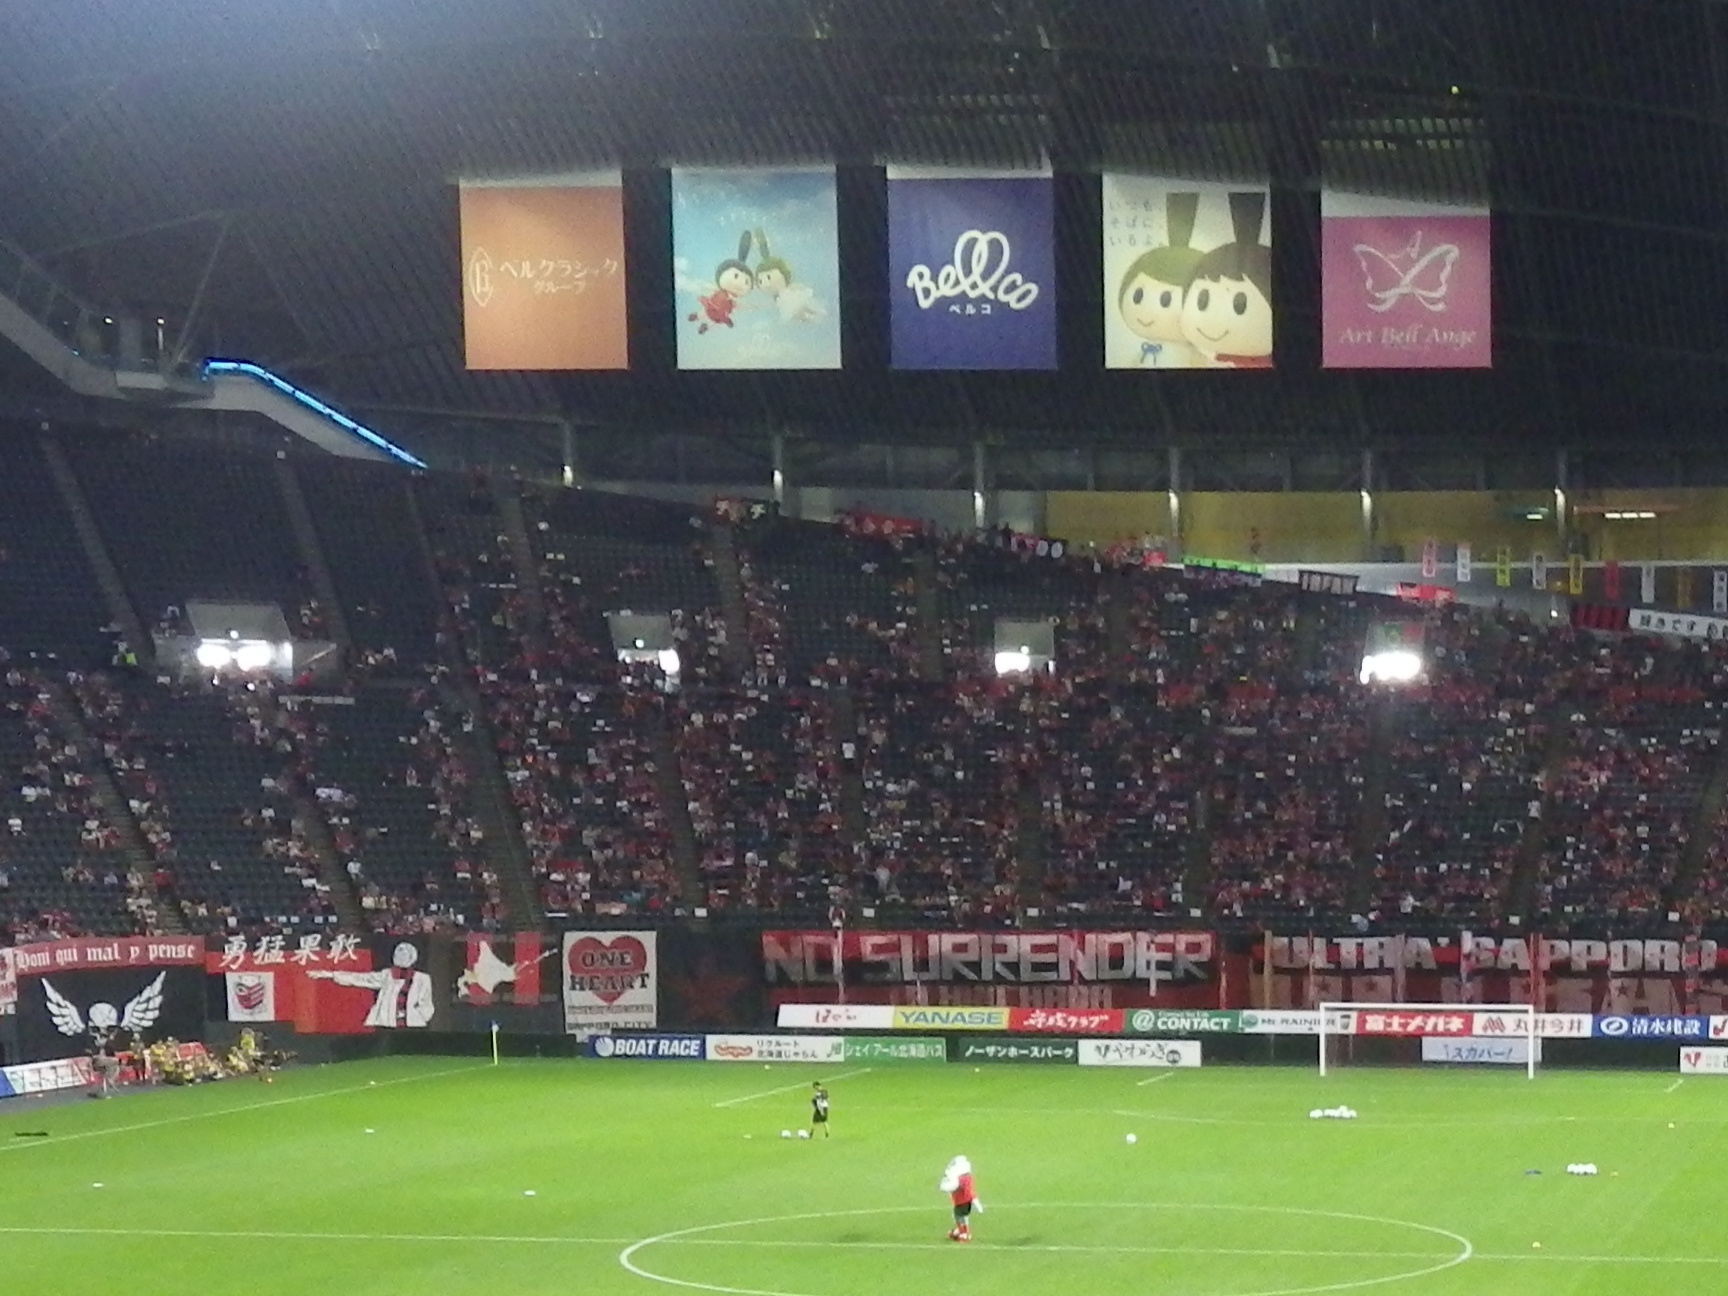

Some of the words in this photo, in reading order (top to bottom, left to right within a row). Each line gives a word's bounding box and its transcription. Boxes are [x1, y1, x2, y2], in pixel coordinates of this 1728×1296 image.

[906, 229, 1040, 310] Bellco
[55, 942, 79, 967] qui
[86, 941, 122, 963] mal
[147, 942, 197, 963] pense
[219, 931, 363, 970] 勇猛果敢
[581, 950, 634, 968] ONE
[762, 934, 842, 983] NO
[859, 931, 1213, 982] SURRENDER
[568, 972, 651, 992] HEART
[899, 1010, 1005, 1027] YANASE
[1156, 1017, 1232, 1031] CONTACT
[1279, 1017, 1337, 1027] RAINIR
[1365, 1014, 1466, 1033] 富士メガネ
[1512, 1016, 1584, 1034] 丸井今井
[1630, 1016, 1702, 1036] 清水建設
[614, 1037, 658, 1058] BOAT
[659, 1038, 701, 1058] RACE
[964, 1044, 1075, 1060] ノーザンホースパーク
